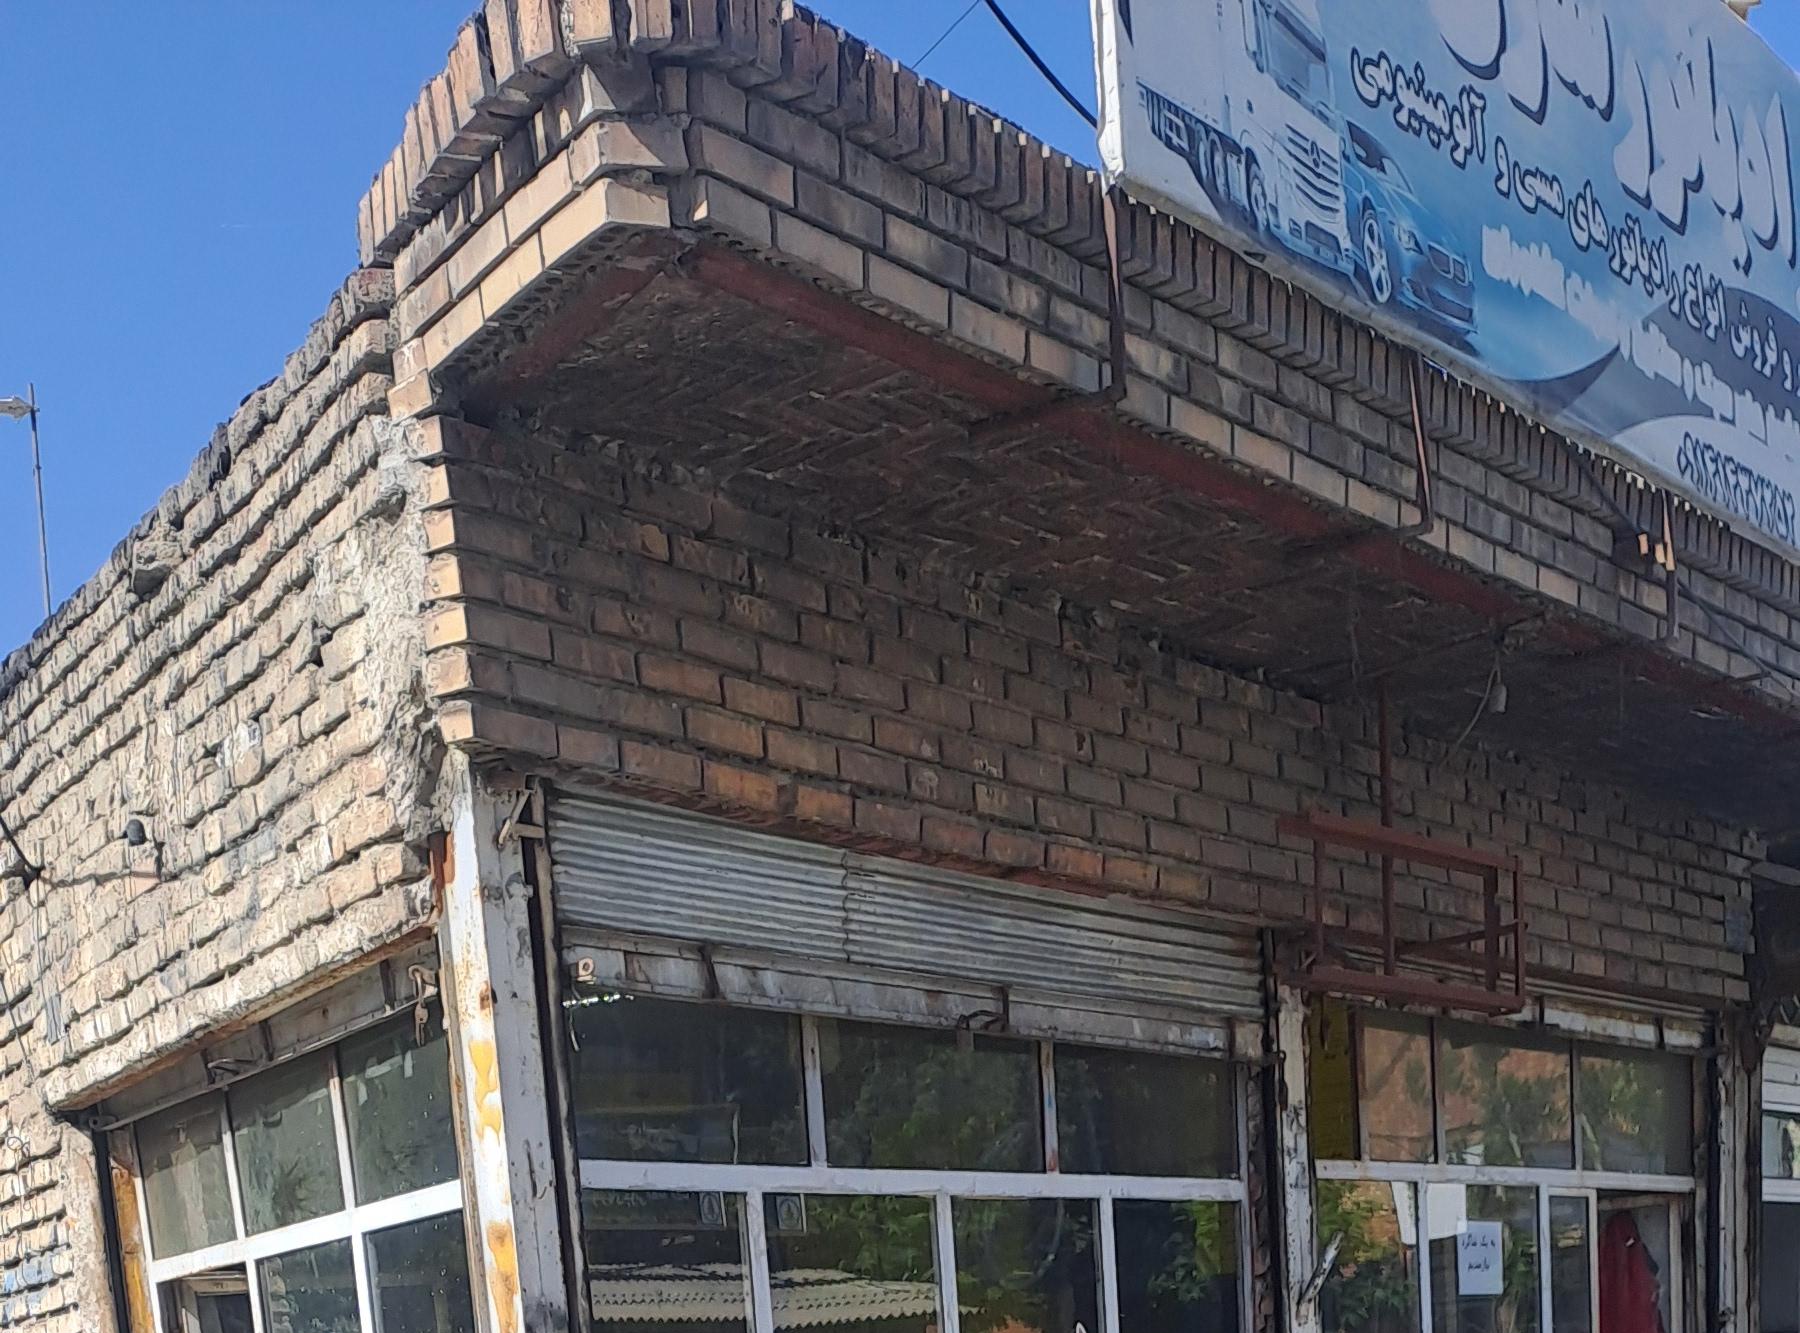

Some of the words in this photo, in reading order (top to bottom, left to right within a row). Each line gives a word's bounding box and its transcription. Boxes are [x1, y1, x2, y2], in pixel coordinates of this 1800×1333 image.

[1350, 46, 1487, 171] آلومینیومی
[1612, 14, 1800, 285] ادیاتور
[1494, 135, 1511, 200] و
[1512, 159, 1566, 219] مسی
[1683, 260, 1727, 343] انواع
[1729, 297, 1779, 379] فروش
[1781, 347, 1795, 393] و
